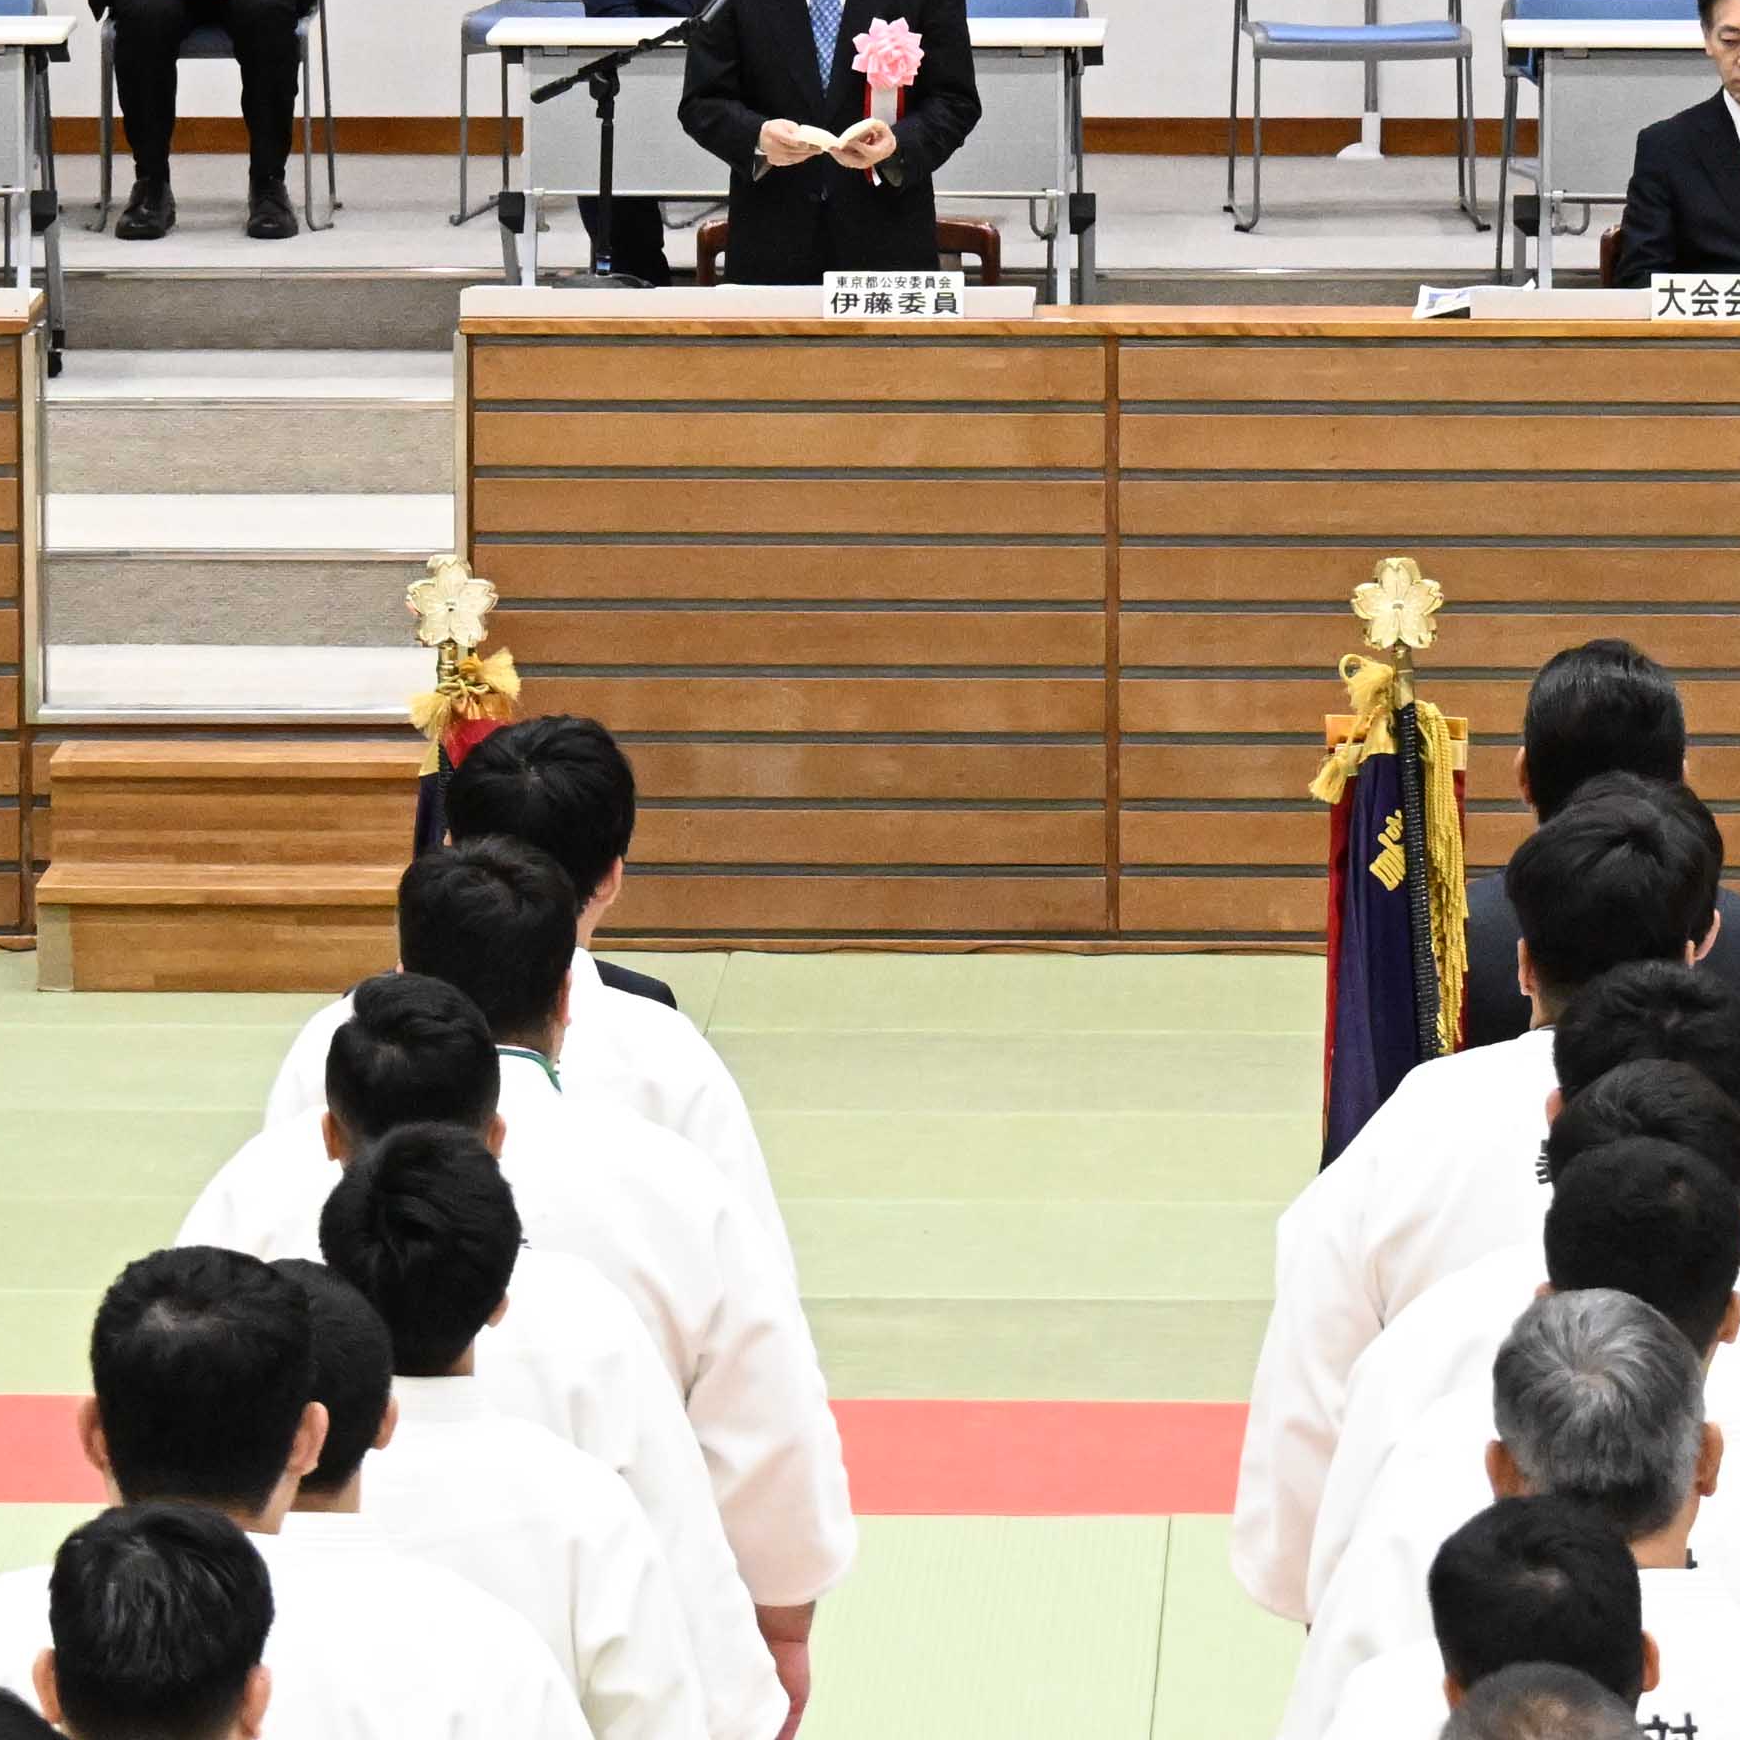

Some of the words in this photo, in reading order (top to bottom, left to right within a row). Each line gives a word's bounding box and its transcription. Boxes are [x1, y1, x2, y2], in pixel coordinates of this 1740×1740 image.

[836, 275, 952, 289] 東京都公安委員会
[830, 291, 959, 314] 伊藤委員
